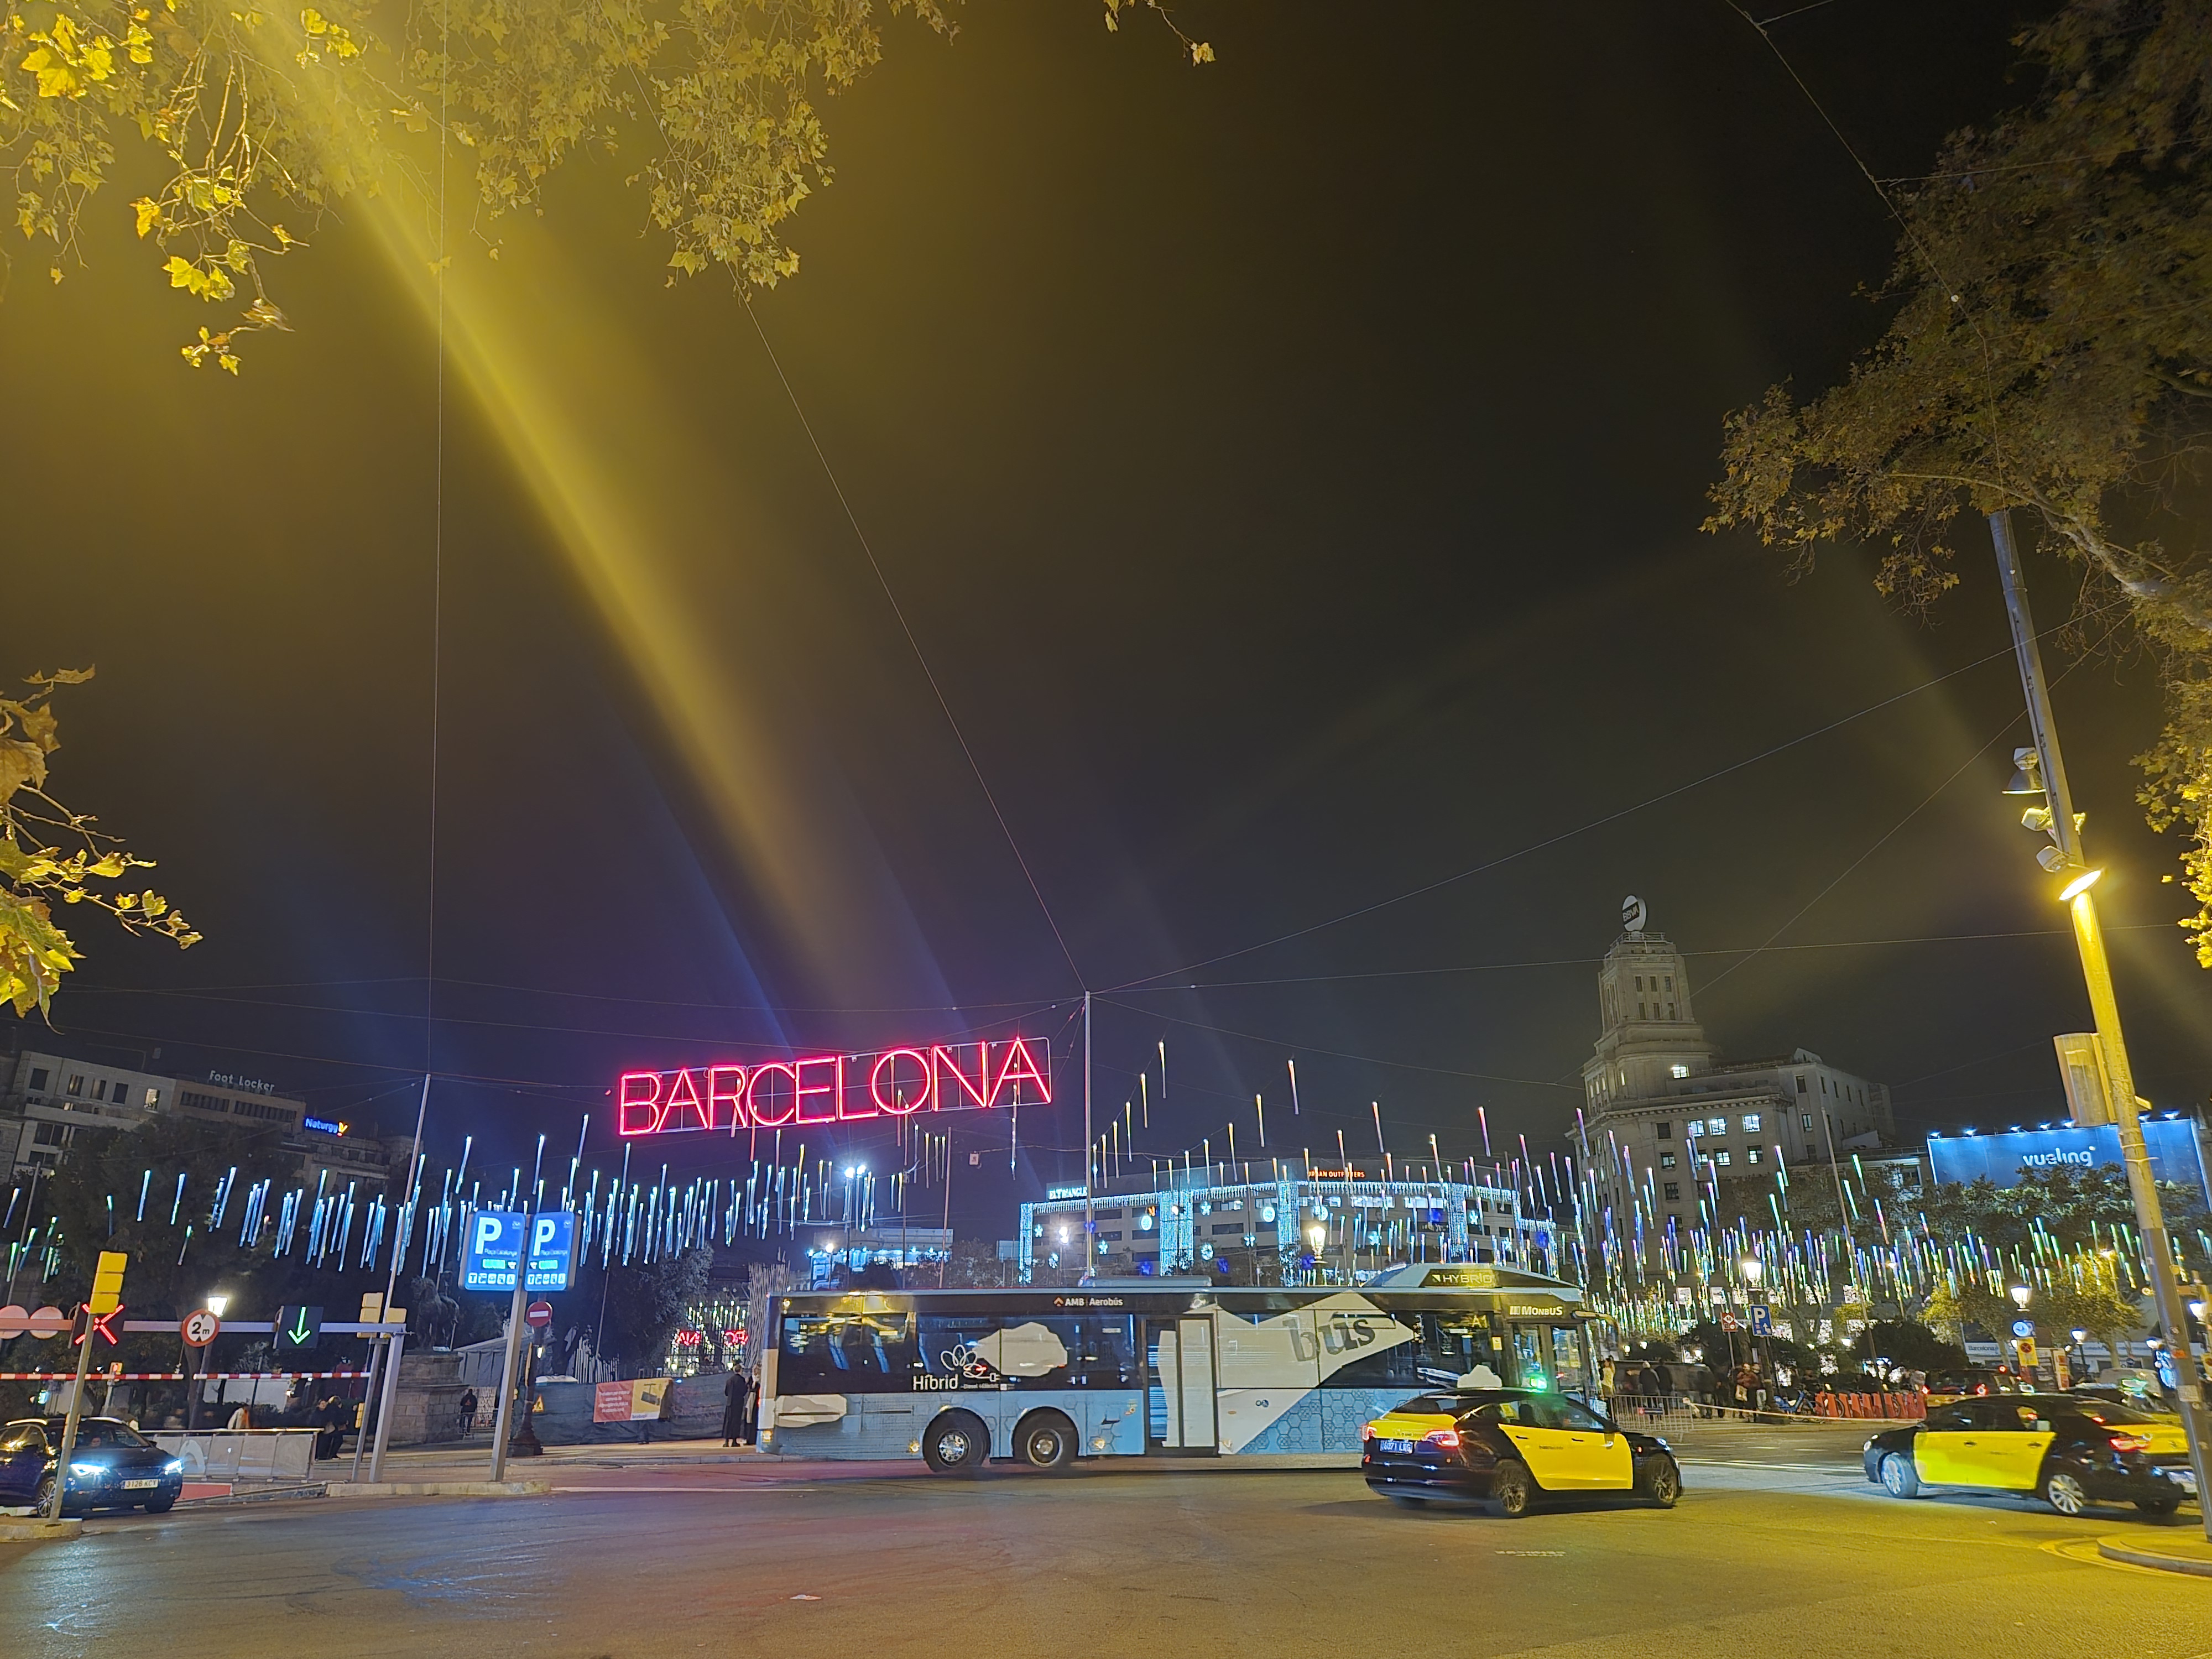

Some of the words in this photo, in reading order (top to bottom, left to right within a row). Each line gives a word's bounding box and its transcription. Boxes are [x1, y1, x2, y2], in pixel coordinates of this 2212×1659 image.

[210, 1070, 233, 1084] Foot
[239, 1076, 275, 1092] Locker
[619, 1036, 1052, 1136] BARCELONA
[305, 1118, 338, 1134] Naturgy
[2022, 1147, 2093, 1167] vueling
[475, 1217, 502, 1255] P
[533, 1219, 556, 1256] P
[1065, 1298, 1084, 1306] AMB
[1089, 1297, 1123, 1306] Aerobús
[1521, 1306, 1563, 1316] MONBUS
[1753, 1307, 1766, 1323] P
[191, 1321, 201, 1334] 2
[1472, 1314, 1488, 1328] A1
[1282, 1319, 1375, 1361] bus
[913, 1374, 958, 1390] Híbrid
